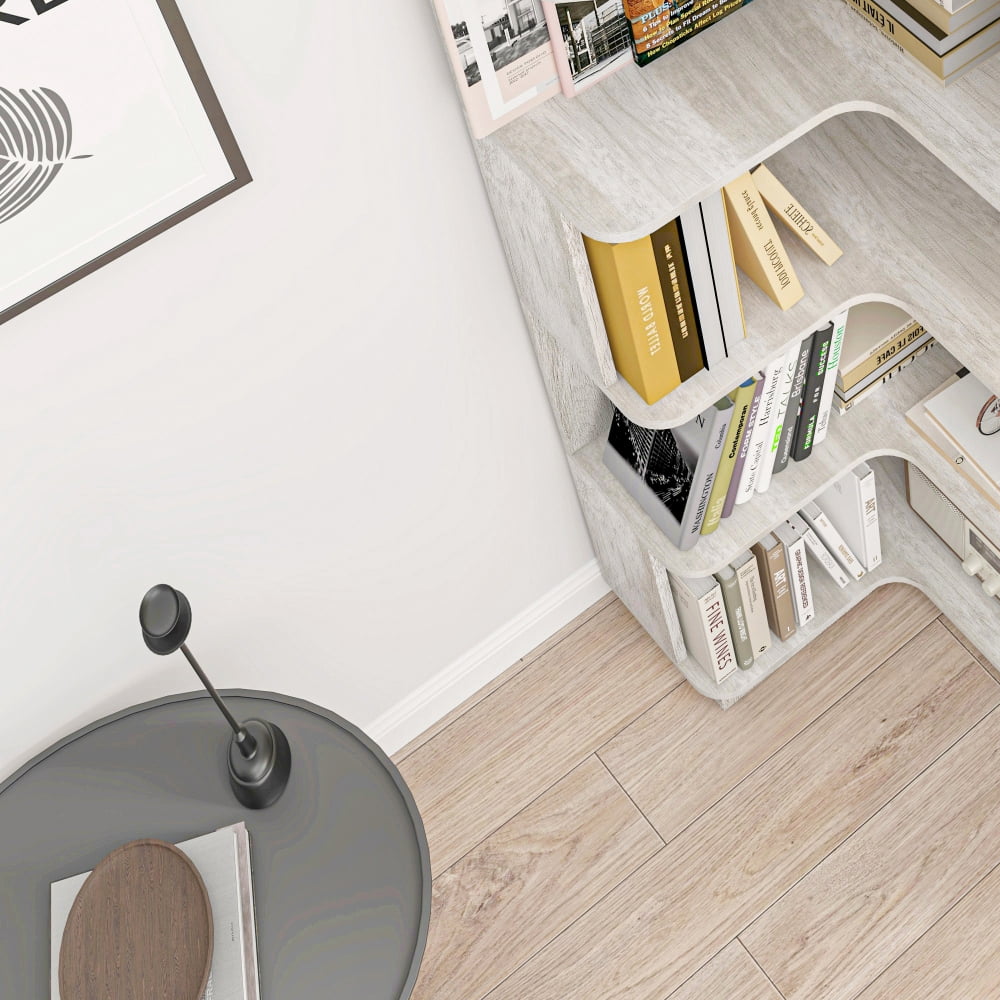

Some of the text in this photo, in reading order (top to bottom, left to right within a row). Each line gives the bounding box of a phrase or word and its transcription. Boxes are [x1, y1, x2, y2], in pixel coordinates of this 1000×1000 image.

[639, 1, 673, 24] PLUS:
[643, 29, 658, 41] How
[665, 17, 680, 28] Plan
[679, 4, 703, 21] Special
[648, 18, 662, 29] Tips
[669, 0, 696, 18] Improve
[651, 29, 675, 45] Secrets
[682, 19, 692, 27] Fit
[691, 7, 712, 22] Dream
[860, 0, 886, 28] ÉTAIT
[886, 20, 896, 35] IL
[647, 46, 662, 58] How
[661, 27, 694, 49] Chopsticks
[693, 15, 712, 30] Affect
[711, 8, 724, 19] Log
[816, 340, 829, 376] SUCCESS
[828, 325, 845, 371] Houston
[791, 349, 809, 398] Brisbane
[759, 365, 783, 428] Harrisburg
[728, 404, 748, 459] Contemporan
[740, 396, 760, 459] FORM STYLE
[804, 415, 816, 450] FORMULA
[691, 472, 713, 534] WASHINGTON
[705, 601, 724, 633] FINE
[713, 631, 732, 671] WINES
